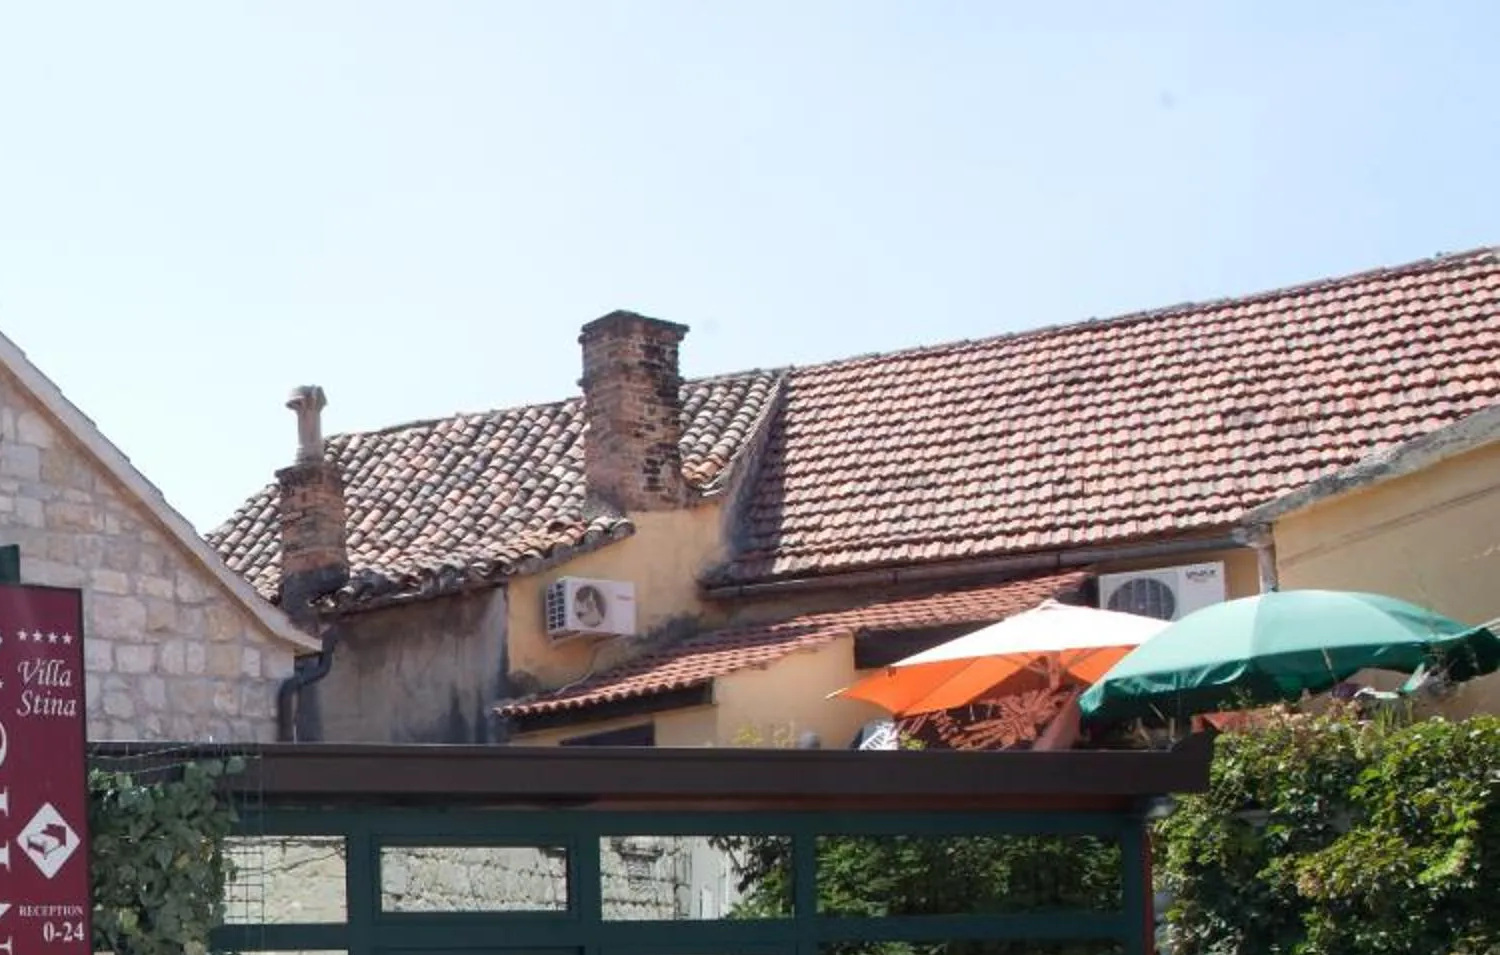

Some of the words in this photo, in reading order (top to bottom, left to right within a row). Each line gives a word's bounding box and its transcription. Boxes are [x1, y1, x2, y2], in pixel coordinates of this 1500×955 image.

[17, 659, 73, 687] Villa
[15, 688, 77, 717] Stina
[19, 904, 84, 917] RECEPTION
[43, 921, 85, 942] 0-24
